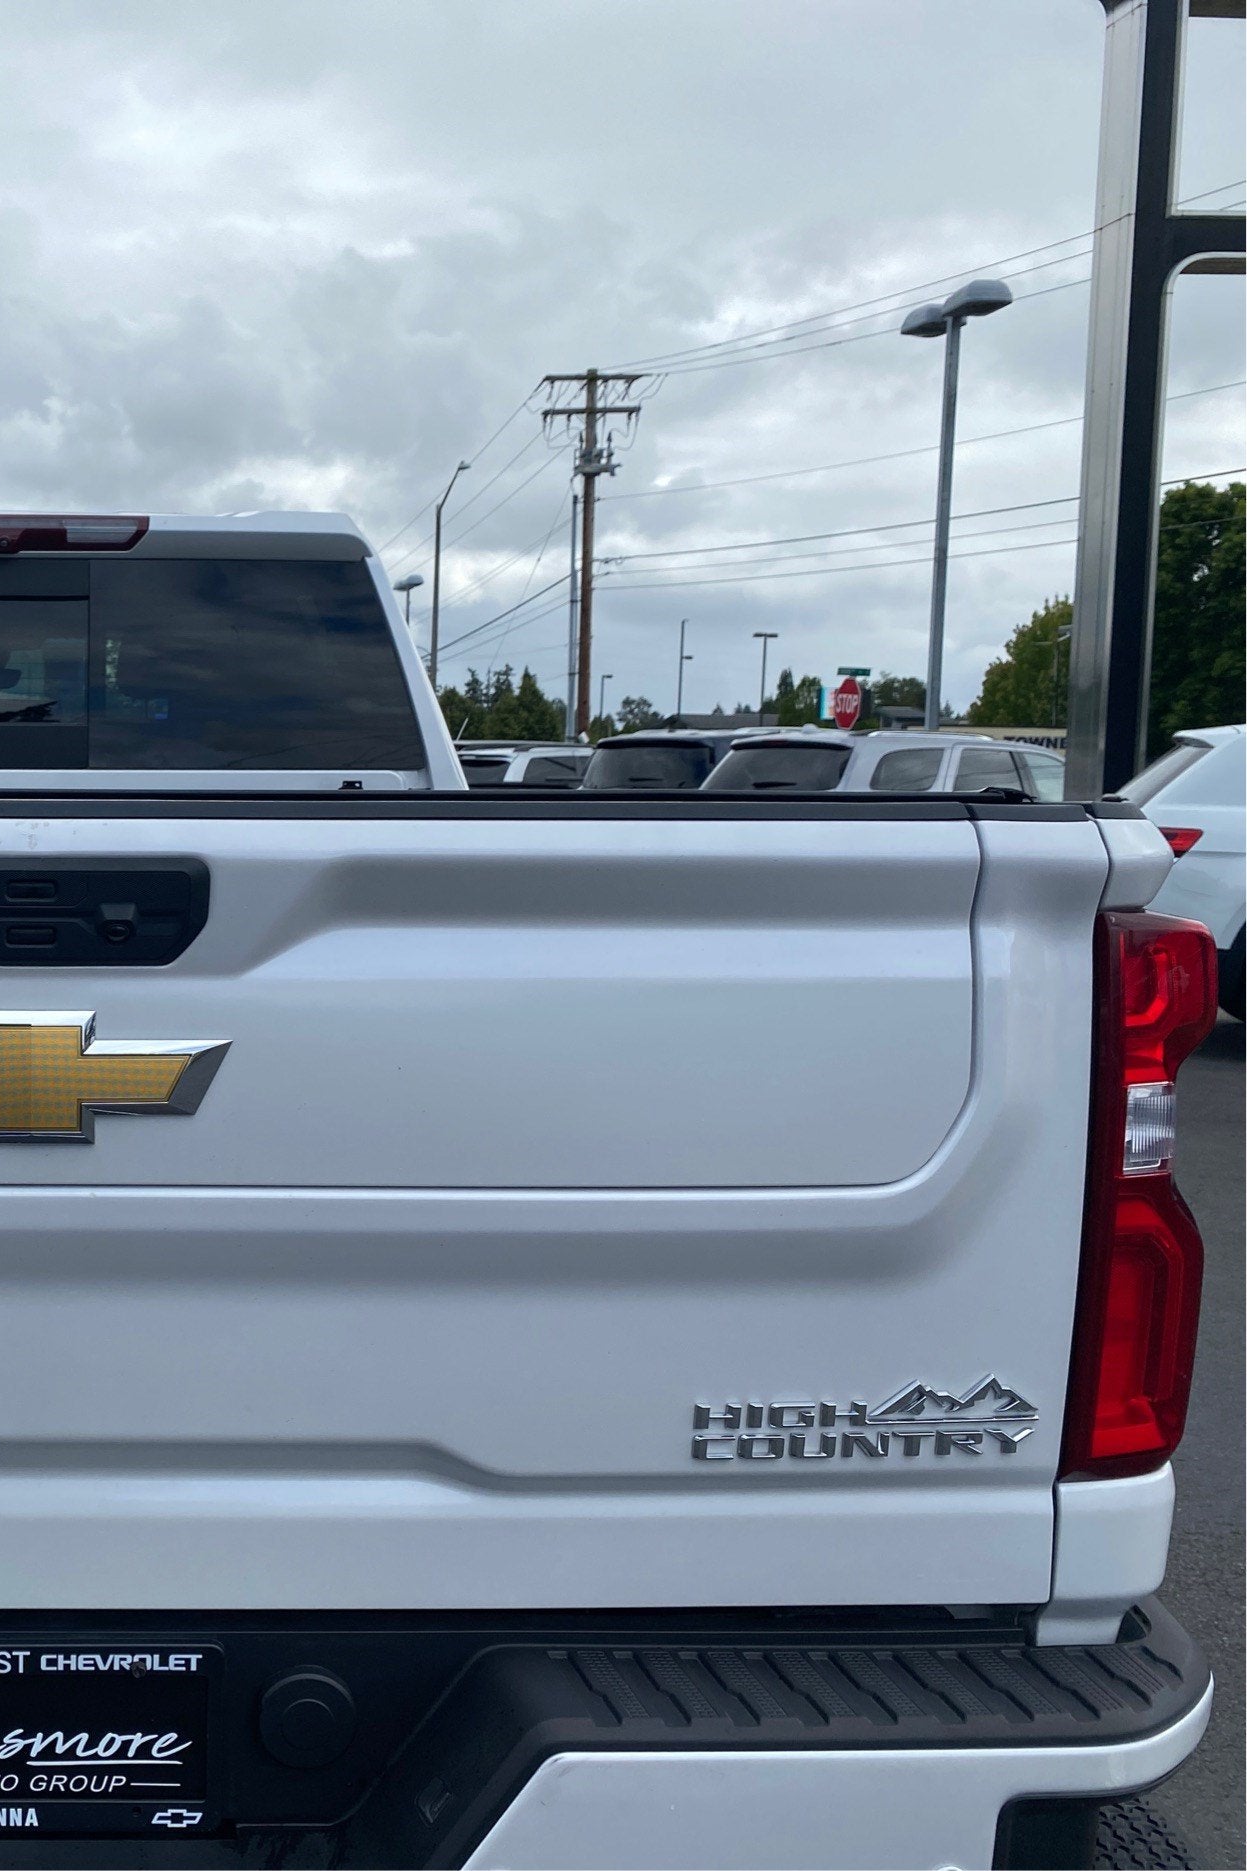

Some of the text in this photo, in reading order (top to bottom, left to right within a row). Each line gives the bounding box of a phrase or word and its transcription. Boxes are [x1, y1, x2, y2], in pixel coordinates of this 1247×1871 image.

[836, 693, 858, 713] STOP
[693, 1400, 868, 1430] HIGH
[691, 1427, 1035, 1460] COUNTRY
[40, 1654, 203, 1671] CHEVROLET
[29, 1774, 127, 1793] GROUP
